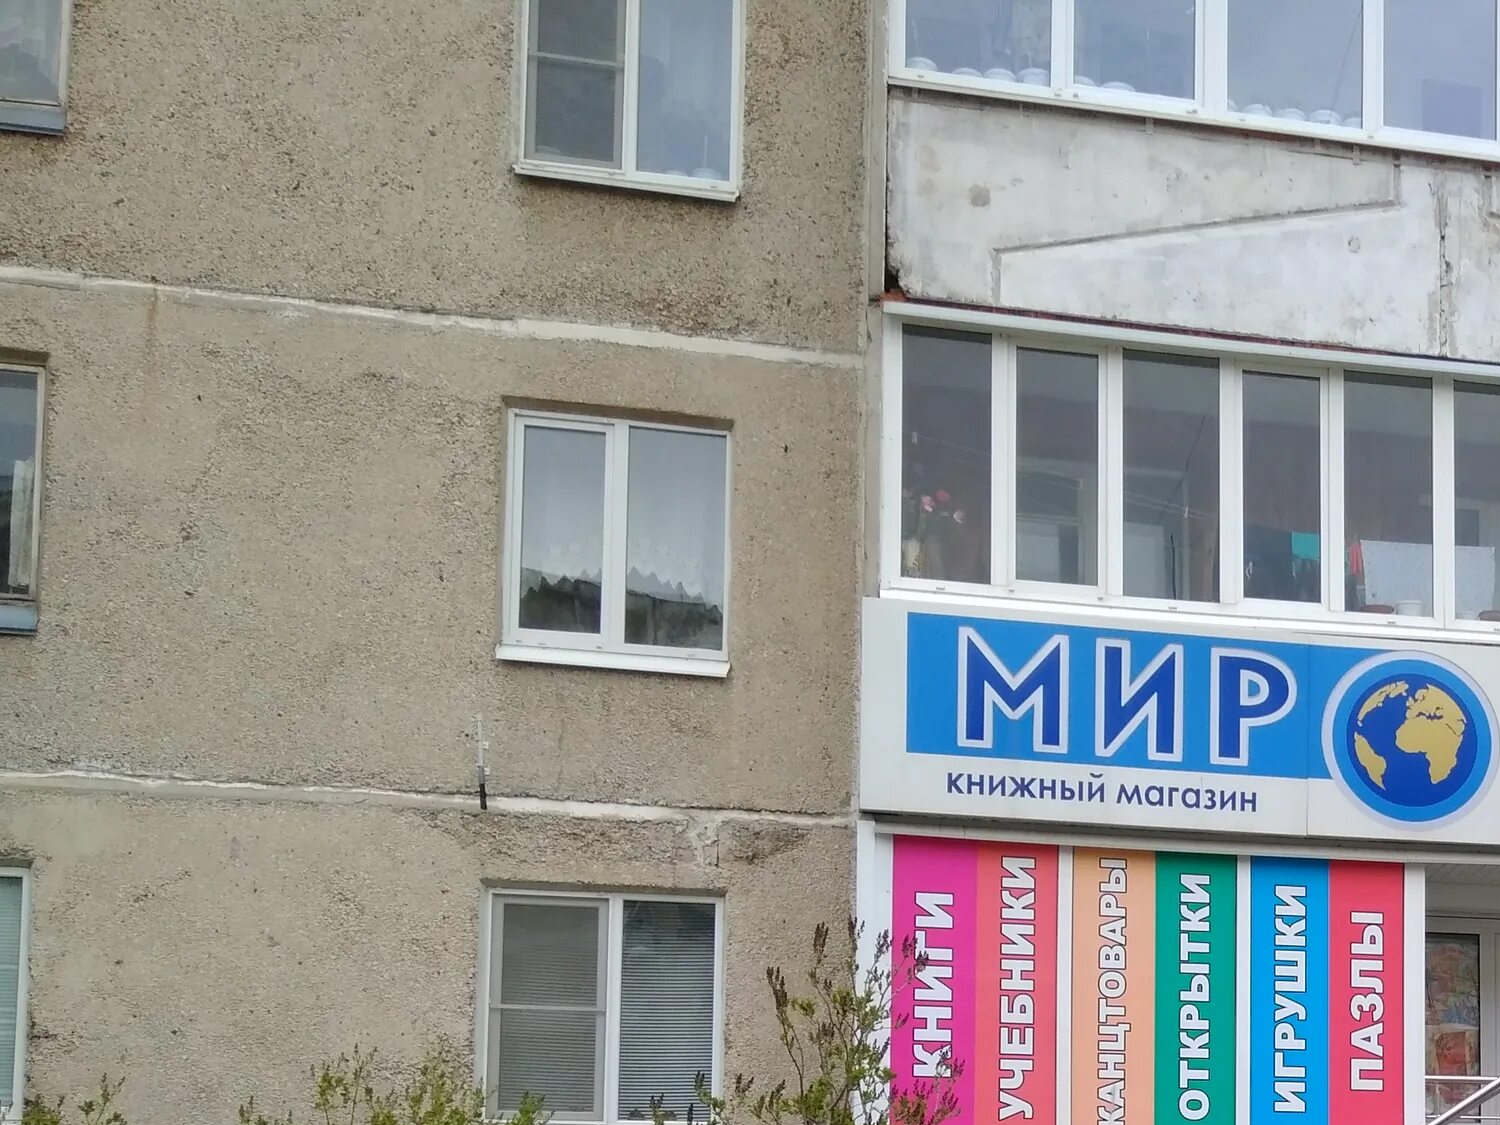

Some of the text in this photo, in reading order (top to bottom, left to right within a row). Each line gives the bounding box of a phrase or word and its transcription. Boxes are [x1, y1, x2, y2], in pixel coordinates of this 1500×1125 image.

[956, 625, 1298, 767] МИР
[946, 771, 1258, 813] книжный магазин
[911, 890, 955, 1078] КНИГИ
[998, 855, 1037, 1122] УЧЕБНИКИ
[1178, 872, 1212, 1122] ОТКРЫТКИ
[1273, 883, 1308, 1114] ИГРУШКИ
[1348, 910, 1385, 1092] ПАЗЛЫ
